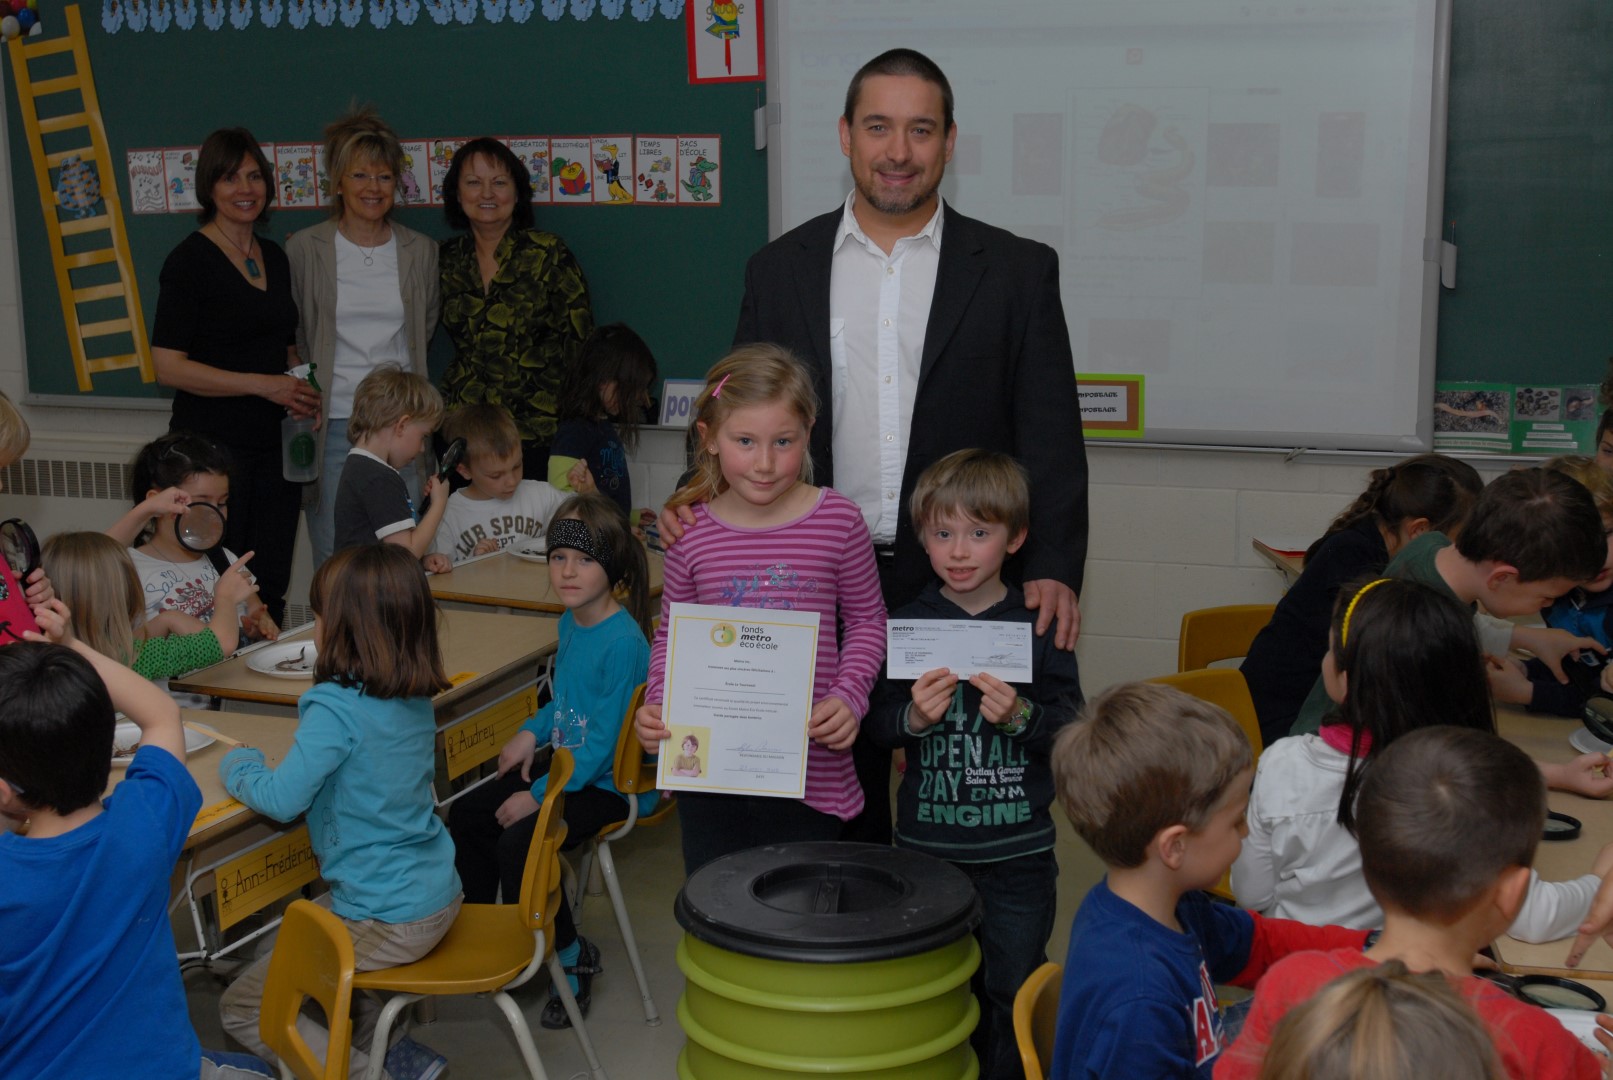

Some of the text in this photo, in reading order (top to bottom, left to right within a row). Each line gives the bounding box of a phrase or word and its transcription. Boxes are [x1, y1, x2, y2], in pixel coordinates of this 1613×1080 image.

[680, 140, 698, 148] SACS
[680, 148, 707, 157] D'ÉCOLE
[456, 515, 543, 559] LUB SPORT
[741, 625, 764, 635] fonds
[740, 633, 772, 642] metro
[739, 641, 778, 651] éco école
[459, 723, 495, 752] Audrey
[920, 733, 1029, 769] OPEN ALL
[997, 766, 1025, 776] Garage
[965, 774, 1023, 785] Sales & Service
[918, 769, 963, 803] DAY
[916, 801, 1032, 828] ENGINE
[236, 843, 314, 898] Ann-Frédériq
